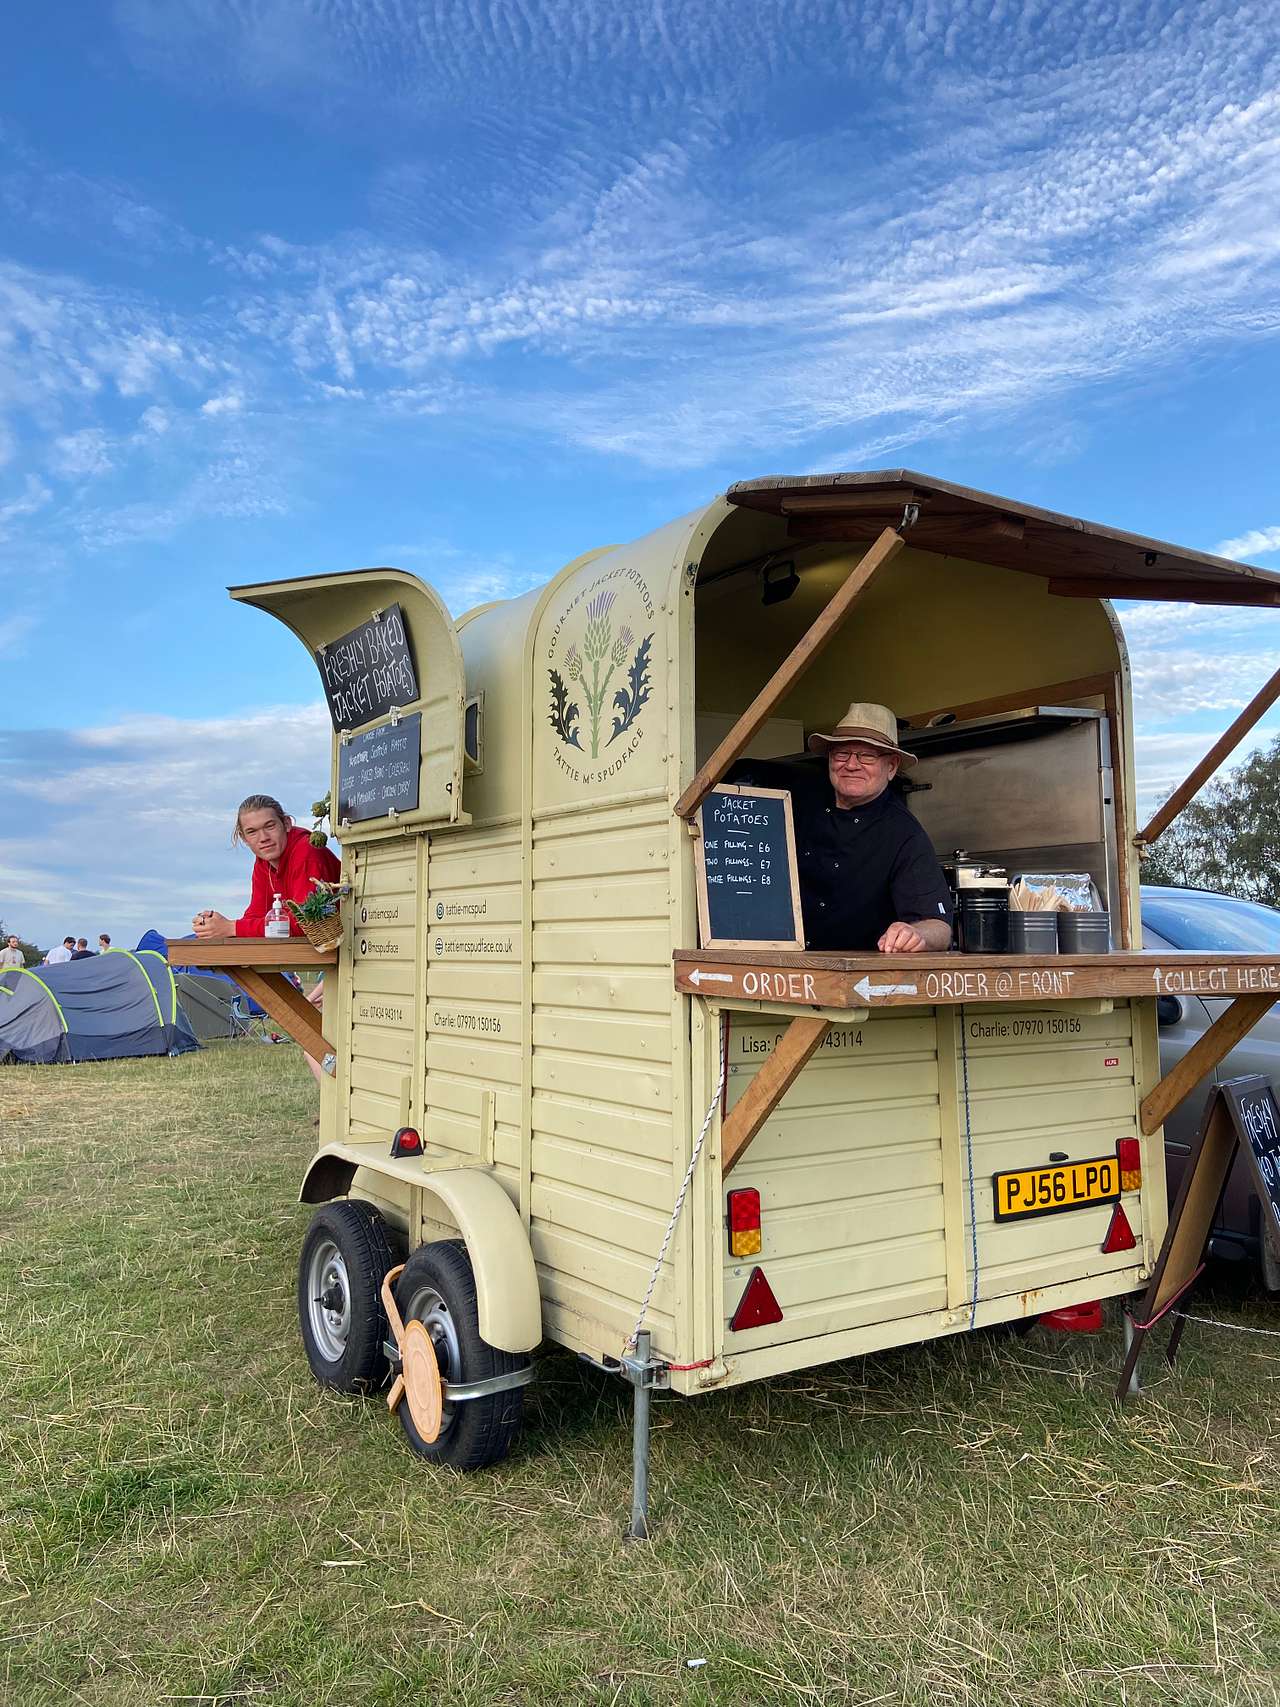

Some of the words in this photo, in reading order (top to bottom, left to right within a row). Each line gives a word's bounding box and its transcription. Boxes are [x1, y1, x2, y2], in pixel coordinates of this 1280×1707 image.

[548, 588, 587, 658] GOURMET
[589, 568, 626, 592] JACKET
[625, 568, 655, 620] POTATOES
[322, 636, 366, 687] FRESHLY
[365, 614, 404, 664] BAKED
[332, 673, 373, 722] JACKET
[372, 654, 414, 703] POTATOES
[553, 747, 579, 781] TATTIE
[598, 728, 643, 782] SPUDFACE
[721, 796, 756, 811] JACKET
[714, 809, 769, 826] POTATOES
[704, 840, 718, 849] ONE
[758, 841, 771, 853] £6
[706, 858, 719, 866] TWO
[760, 859, 771, 869] £7
[761, 874, 771, 885] £8
[445, 899, 487, 918] tattie-mcspud
[445, 938, 513, 957] tattiemcspudface.co.uk
[742, 972, 817, 1000] ORDER
[926, 971, 988, 998] ORDER
[995, 972, 1013, 997] @
[1018, 971, 1075, 996] FRONT
[1164, 967, 1229, 992] COLLECT
[1237, 966, 1279, 989] HERE
[434, 1012, 455, 1027] Charlie:
[457, 1014, 476, 1030] 07970
[477, 1016, 501, 1033] 150156
[970, 1022, 1010, 1038] Charlie:
[1012, 1020, 1043, 1036] 07970
[1046, 1018, 1081, 1034] 150156
[742, 1036, 771, 1053] Lisa:
[1007, 1171, 1066, 1210] PJ56
[1072, 1164, 1112, 1199] LPO
